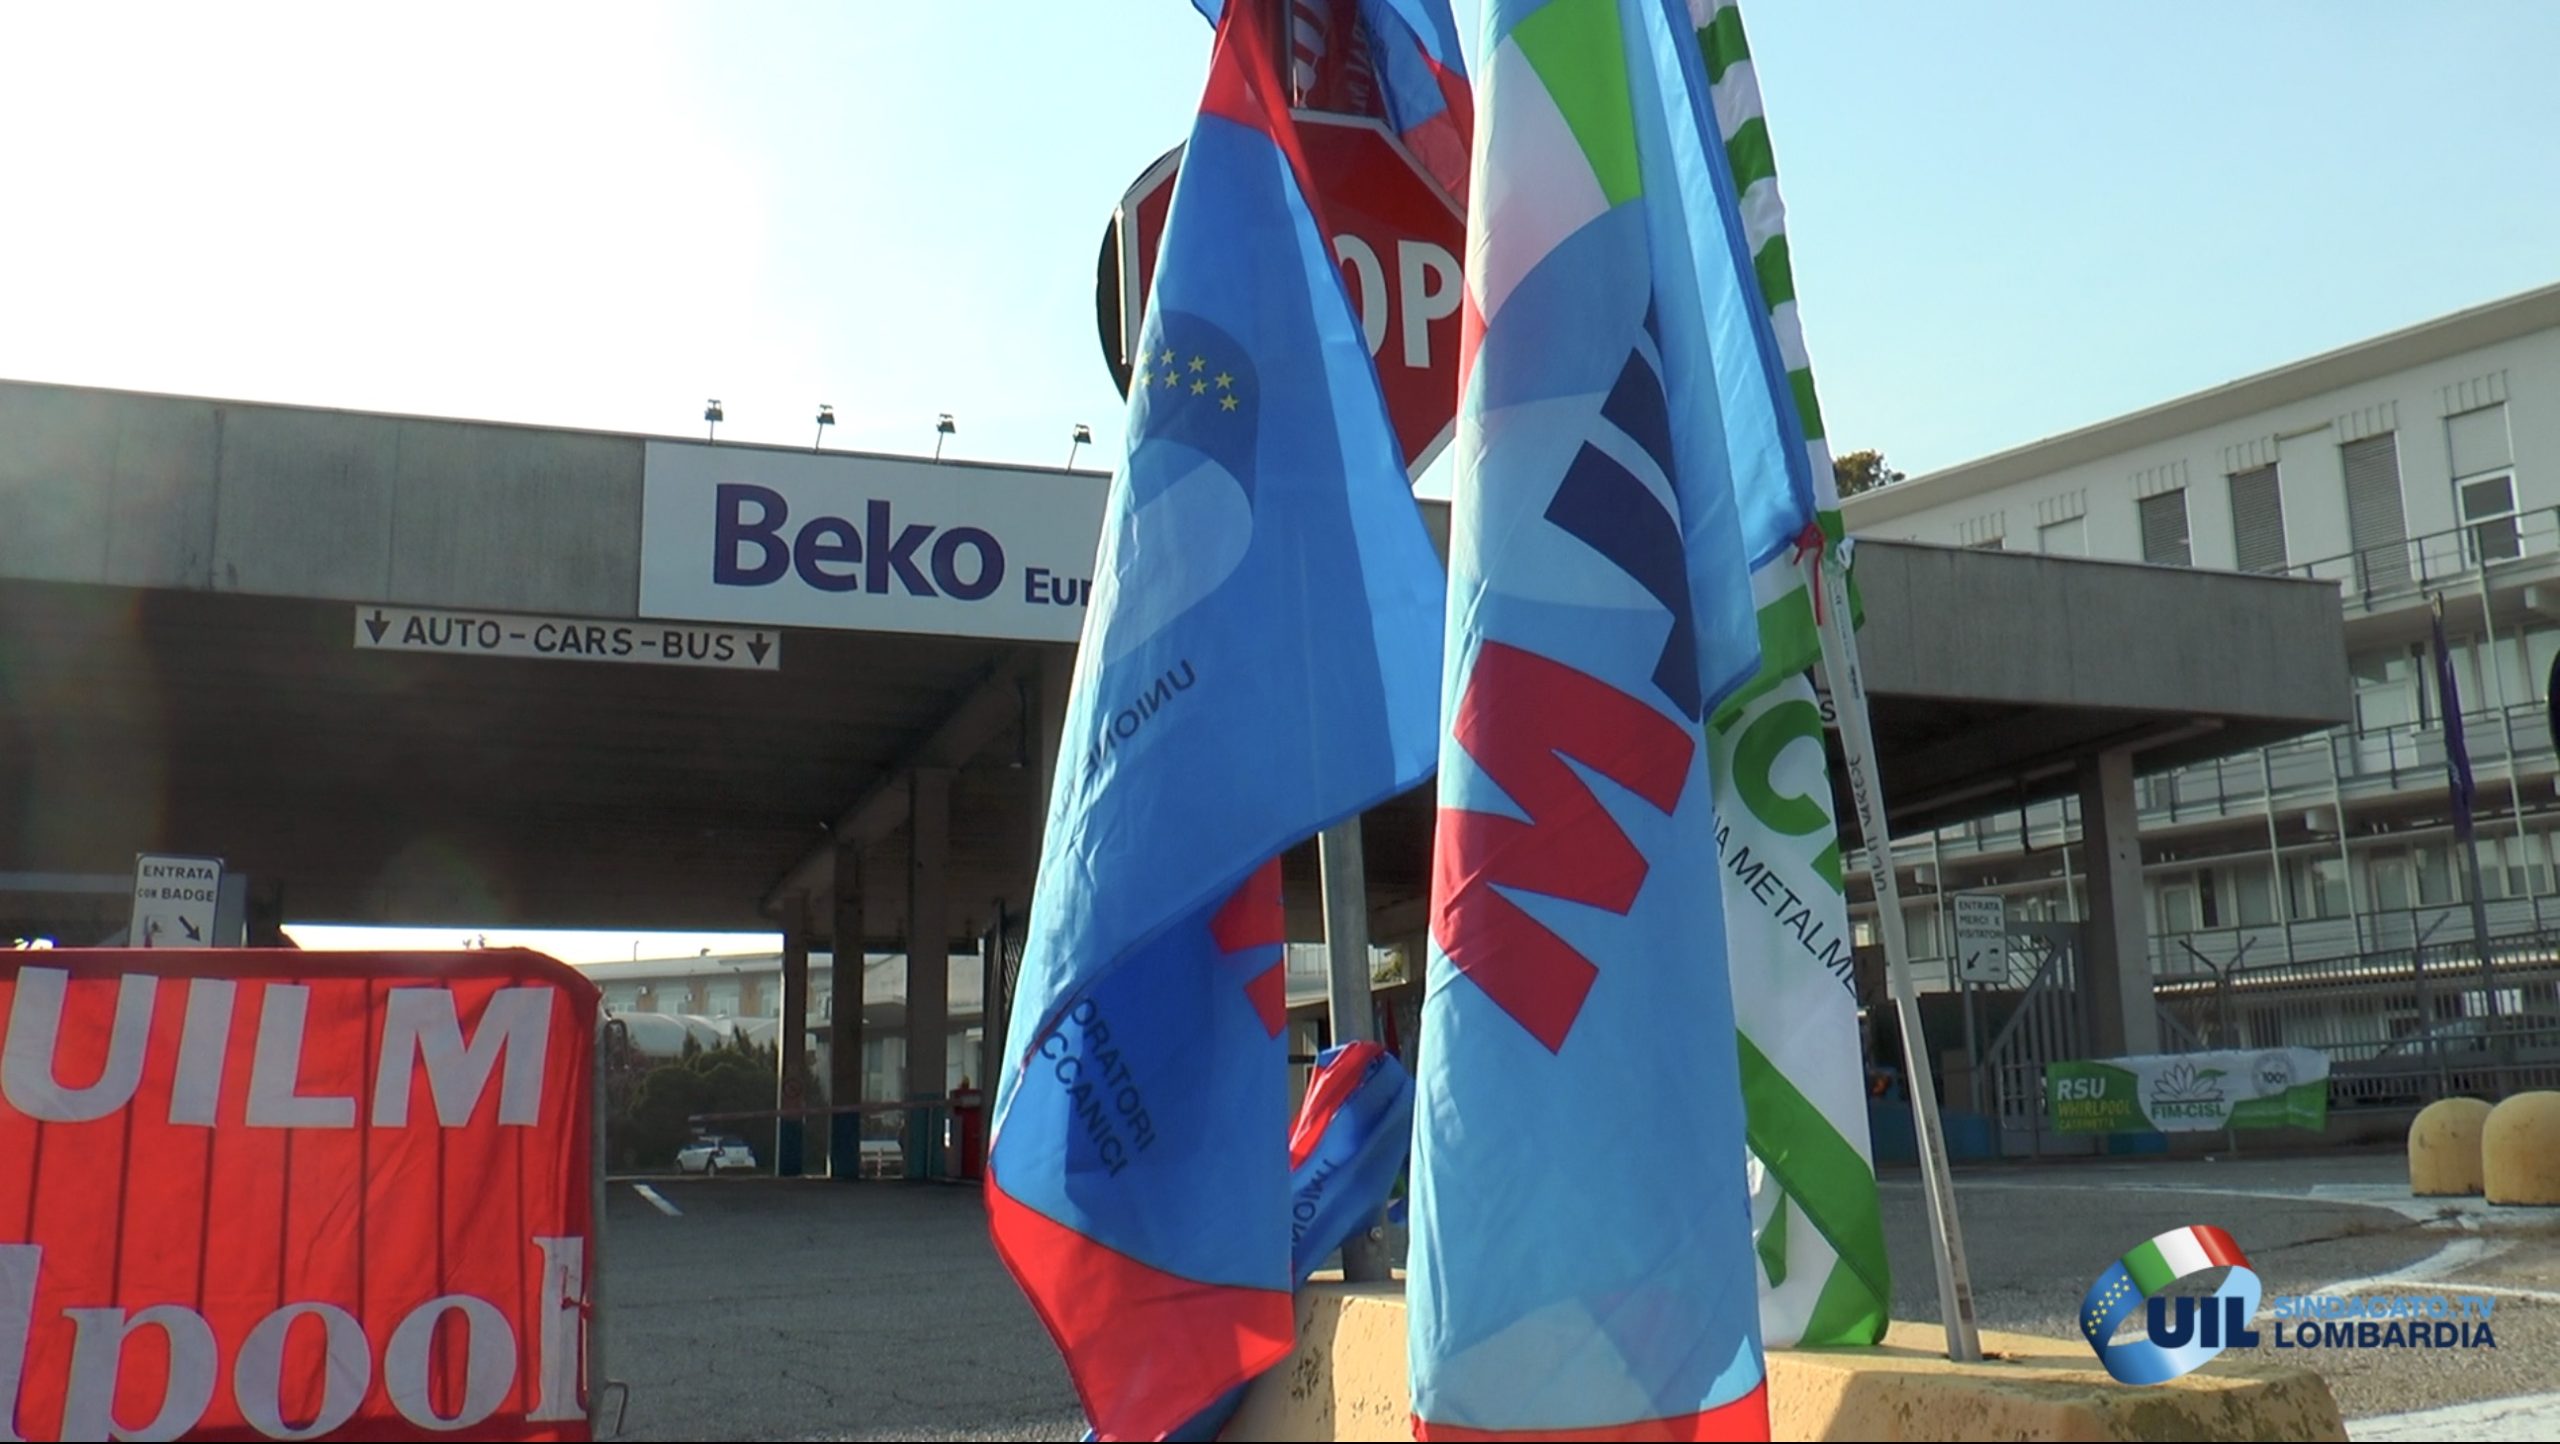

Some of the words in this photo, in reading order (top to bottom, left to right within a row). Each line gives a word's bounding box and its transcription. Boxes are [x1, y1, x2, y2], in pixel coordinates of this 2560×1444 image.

[1332, 233, 1464, 368] OP
[713, 483, 1005, 601] Beko
[143, 865, 214, 880] ENTRATA
[161, 888, 215, 902] BADGE
[1958, 900, 2001, 911] ENTRATA
[0, 966, 554, 1128] UILM
[2057, 1077, 2107, 1100] RSU
[2058, 1100, 2131, 1117] WHIRLPOOL
[2151, 1102, 2227, 1120] FIM-CISL
